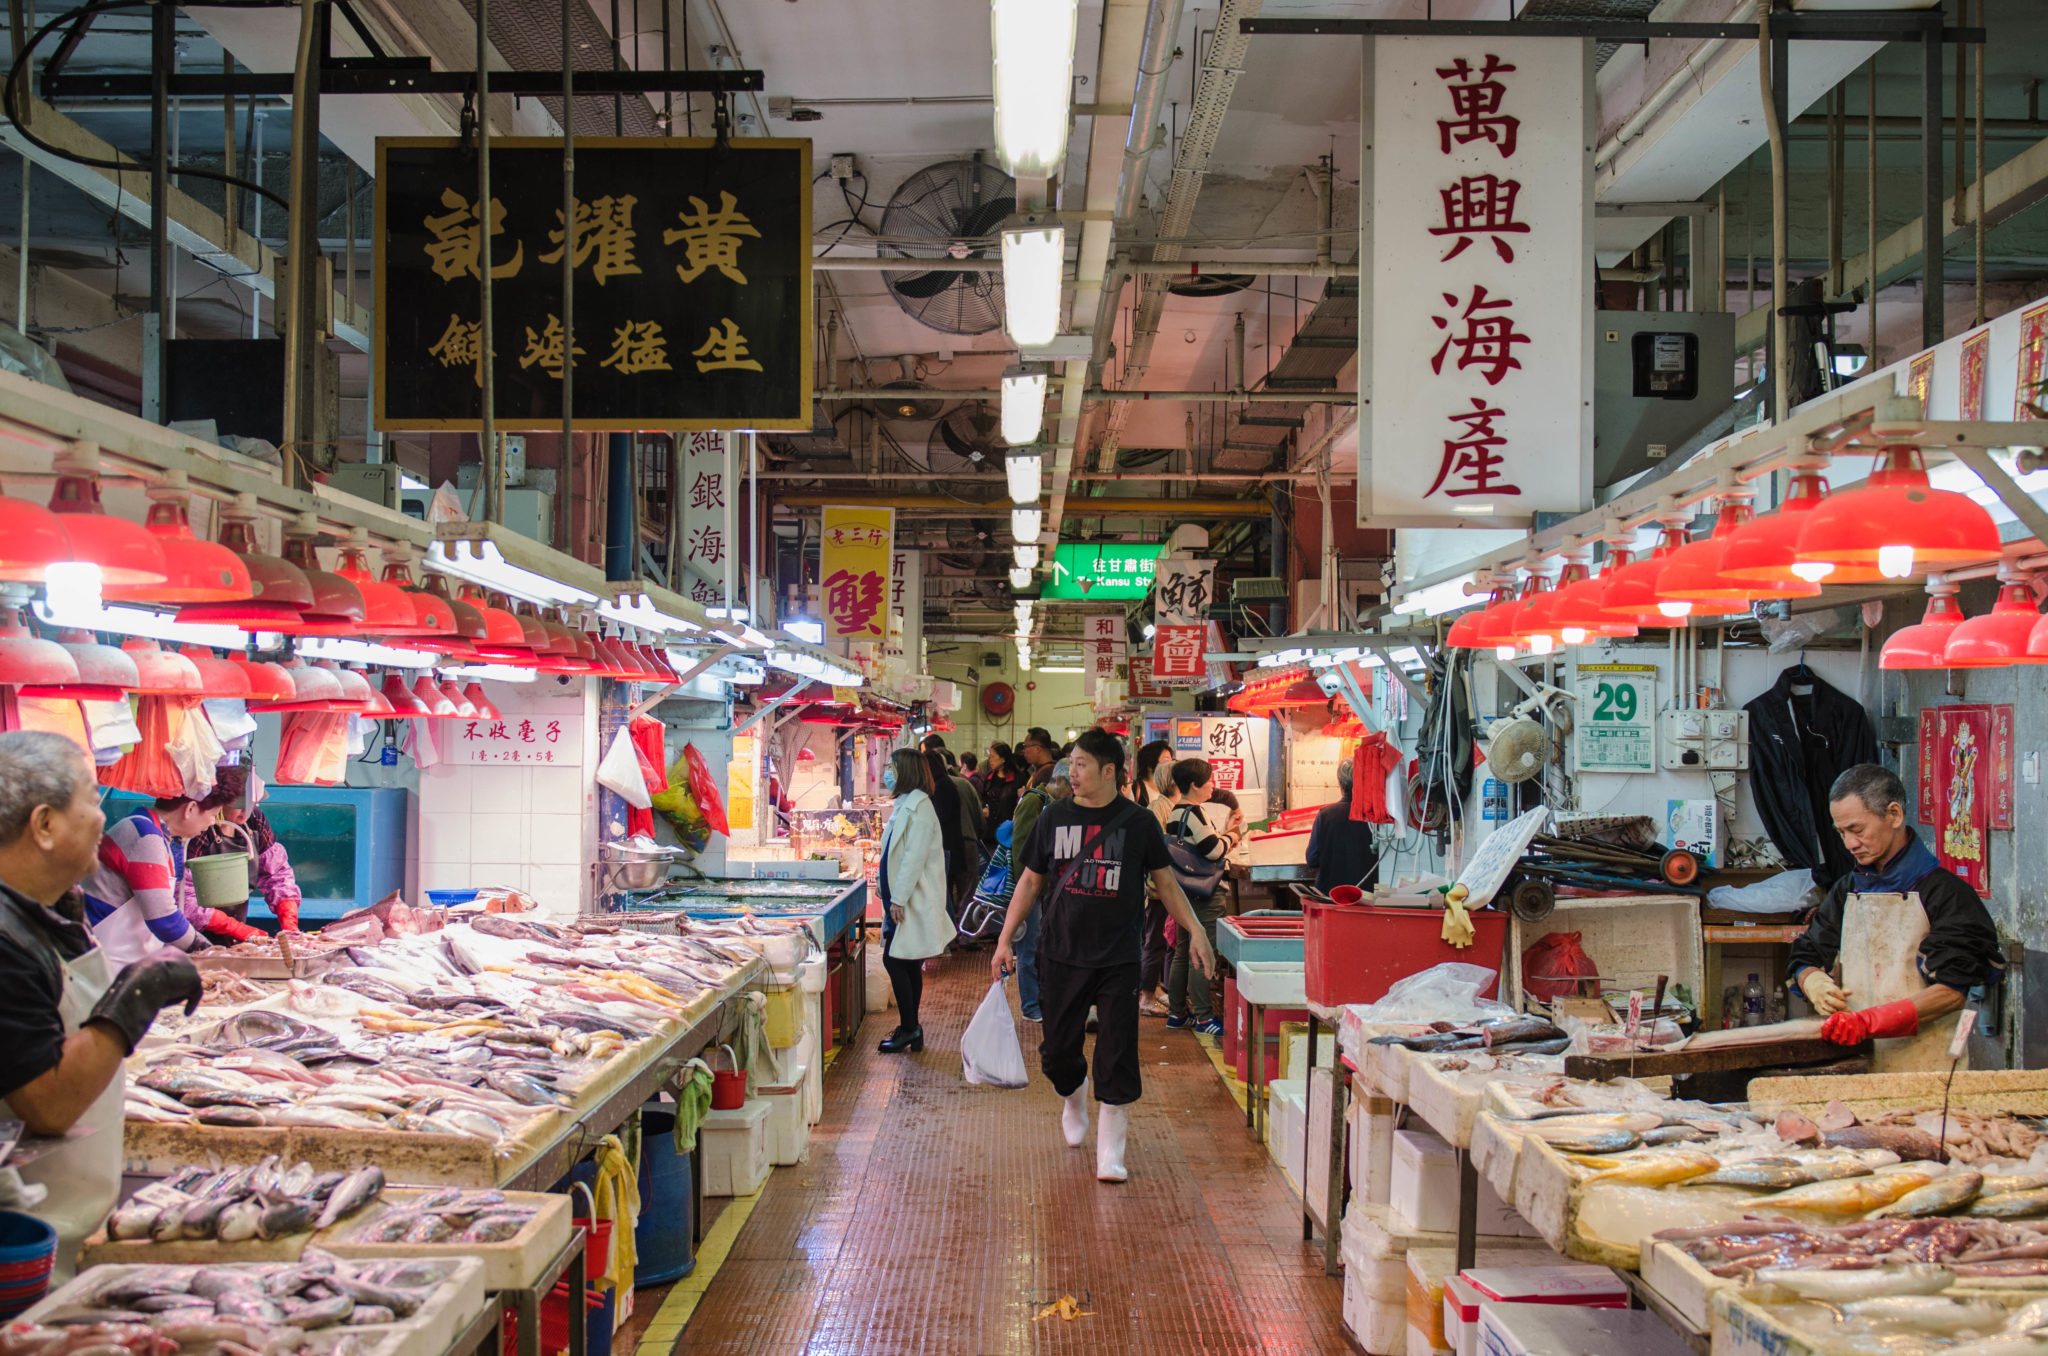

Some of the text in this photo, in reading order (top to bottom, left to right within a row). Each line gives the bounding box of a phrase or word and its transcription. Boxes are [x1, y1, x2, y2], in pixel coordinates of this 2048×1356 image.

[1423, 53, 1532, 500] 萬興海產
[428, 313, 764, 388] 生猛海鮮
[833, 526, 883, 546] 老三行
[1092, 558, 1155, 573] 往甘肅街
[1096, 576, 1130, 587] Kansu
[822, 569, 886, 636] 蟹
[1096, 618, 1113, 678] 和富鮮
[1593, 682, 1637, 721] 29
[463, 719, 562, 743] 不收毫子
